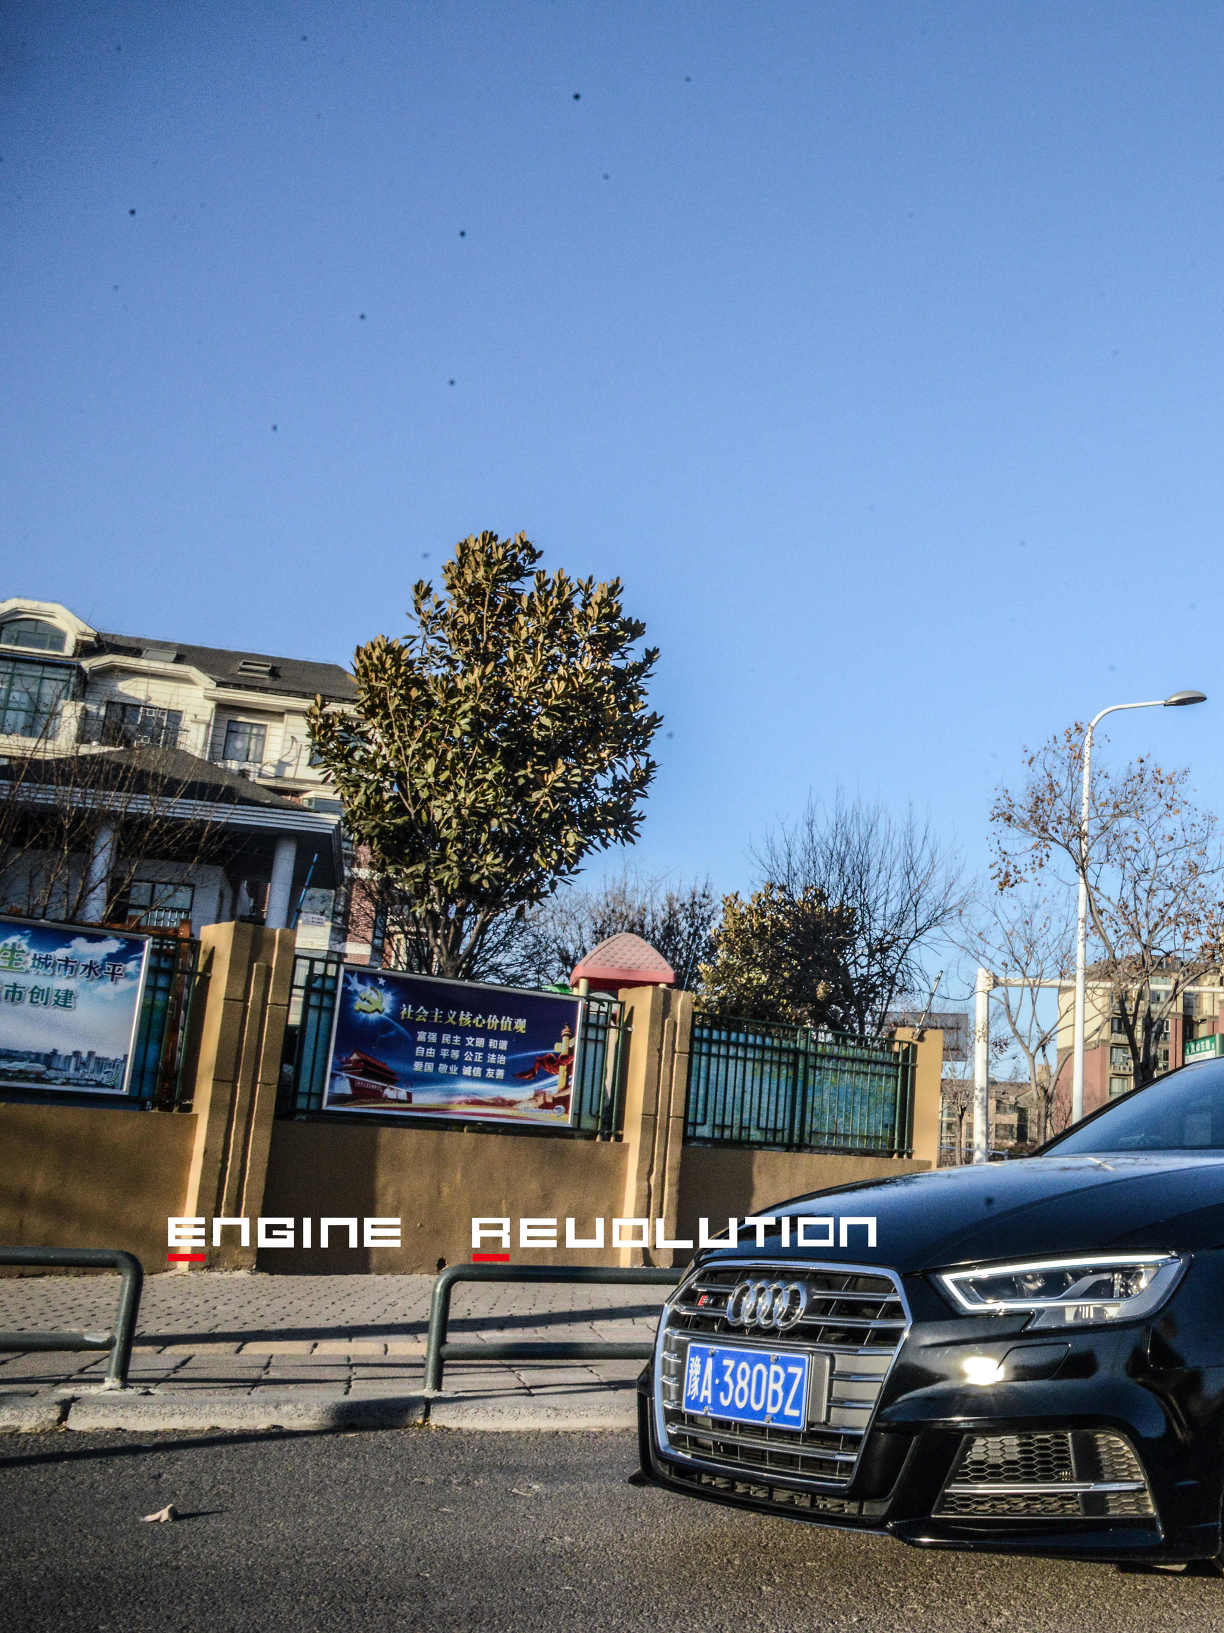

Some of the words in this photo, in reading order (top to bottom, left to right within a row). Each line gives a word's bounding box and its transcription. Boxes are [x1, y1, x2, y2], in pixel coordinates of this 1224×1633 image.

[400, 1003, 527, 1034] 社会主义核心价值观
[416, 1031, 437, 1043] 富强
[441, 1034, 461, 1046] 民主
[465, 1037, 485, 1048] 文明
[489, 1038, 508, 1050] 和谐
[415, 1046, 435, 1058] 自由
[440, 1049, 460, 1060] 平等
[464, 1051, 484, 1063] 公正
[487, 1053, 506, 1065] 法治
[413, 1061, 434, 1073] 爱国
[438, 1063, 458, 1075] 敬业
[462, 1065, 482, 1077] 诚信
[486, 1067, 505, 1079] 友善
